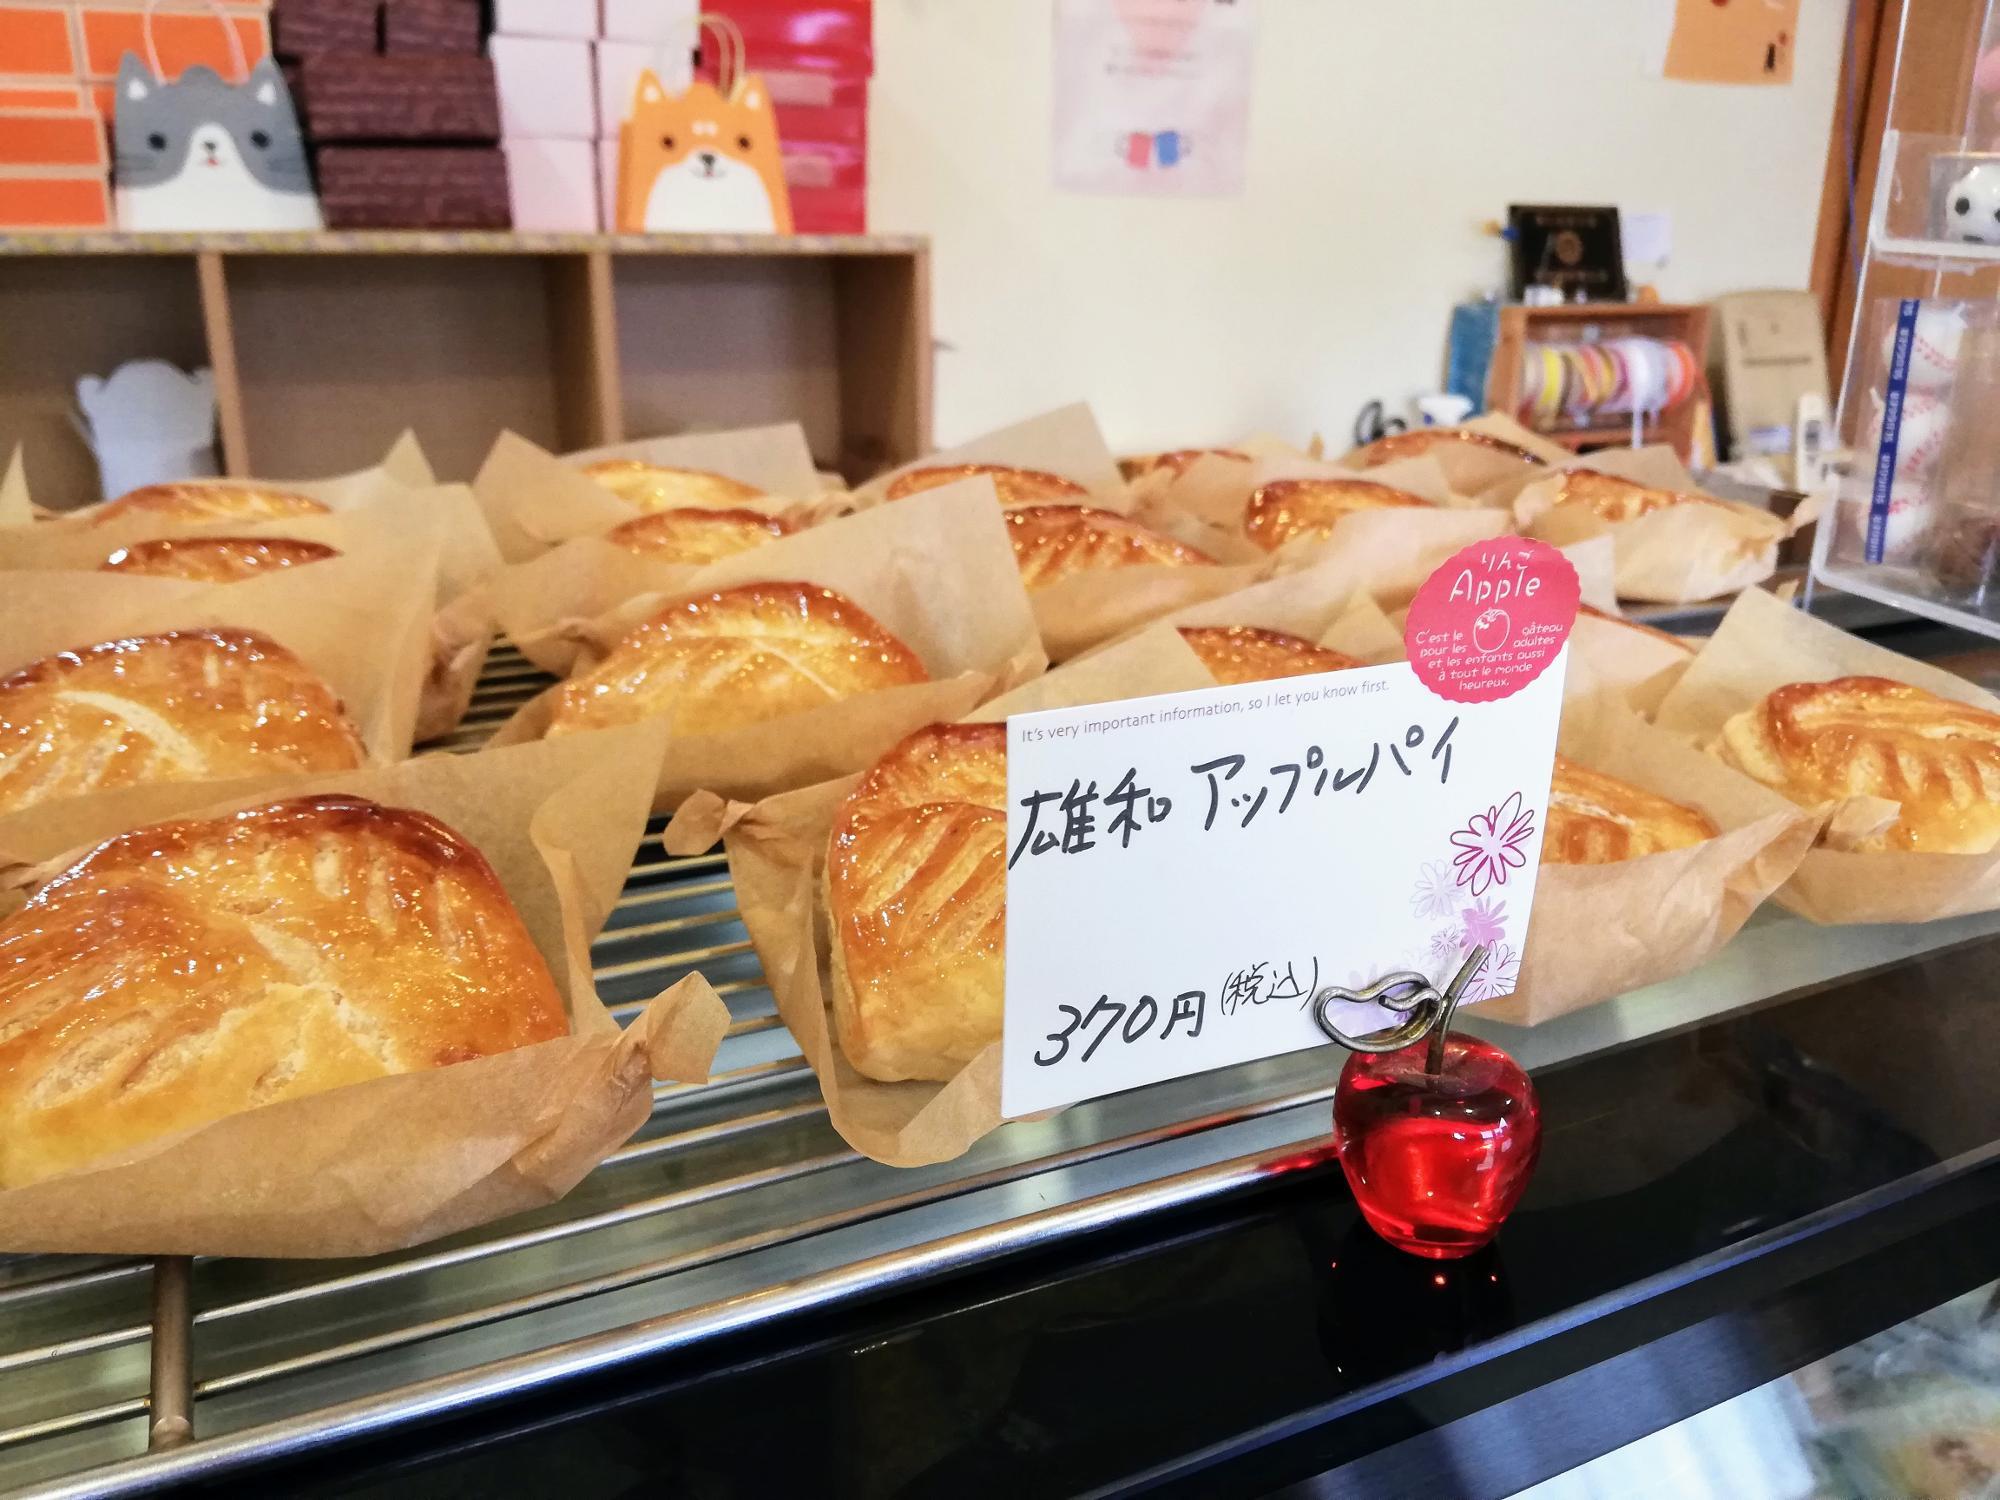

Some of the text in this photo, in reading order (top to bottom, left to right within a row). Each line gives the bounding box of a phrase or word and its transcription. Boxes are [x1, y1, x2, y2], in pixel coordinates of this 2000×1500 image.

[1892, 327, 1909, 381] SLUGGER
[1884, 390, 1900, 443] SLUGGER
[1876, 454, 1891, 505] SLUGGER
[1449, 568, 1541, 605] Apple
[1420, 635, 1556, 659] pour les adultes
[1428, 647, 1545, 669] et les enfants aussi
[1453, 629, 1464, 641] le
[1450, 668, 1479, 680] tout
[1482, 665, 1492, 676] le
[1495, 662, 1533, 675] monde
[1022, 728, 1044, 742] It's
[1048, 723, 1080, 739] very
[1084, 713, 1155, 734] important
[1159, 700, 1244, 722] information,
[1248, 698, 1263, 710] so
[1274, 692, 1293, 706] let
[1296, 687, 1320, 704] you
[1322, 683, 1358, 699] know
[1361, 680, 1391, 693] first.
[1190, 715, 1460, 832] アップルパイ
[1033, 990, 1207, 1068] 370円
